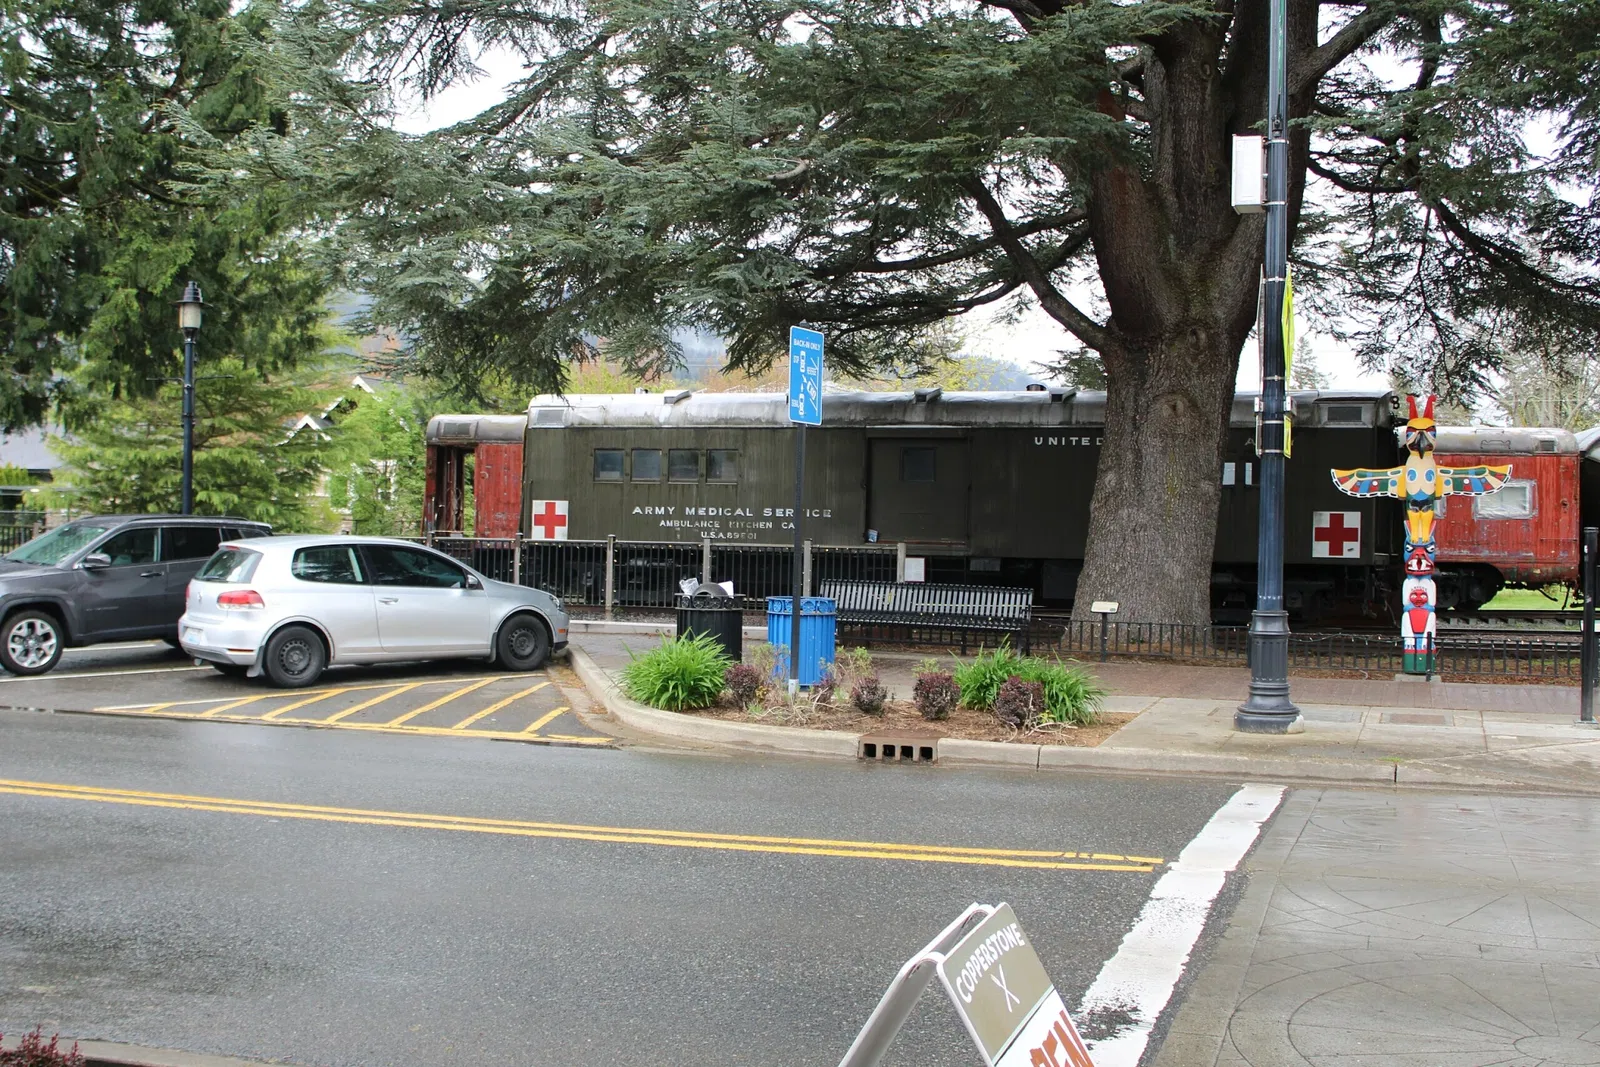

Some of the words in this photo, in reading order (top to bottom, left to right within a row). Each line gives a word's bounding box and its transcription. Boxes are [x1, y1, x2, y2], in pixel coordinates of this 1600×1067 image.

[632, 506, 676, 515] ARMY
[685, 506, 754, 517] MEDICAL
[763, 507, 832, 518] SERICE
[659, 519, 721, 528] AMBULANCE
[728, 520, 773, 529] KITCHEN
[781, 522, 796, 530] CA
[955, 922, 1026, 1004] COPPERSTONE
